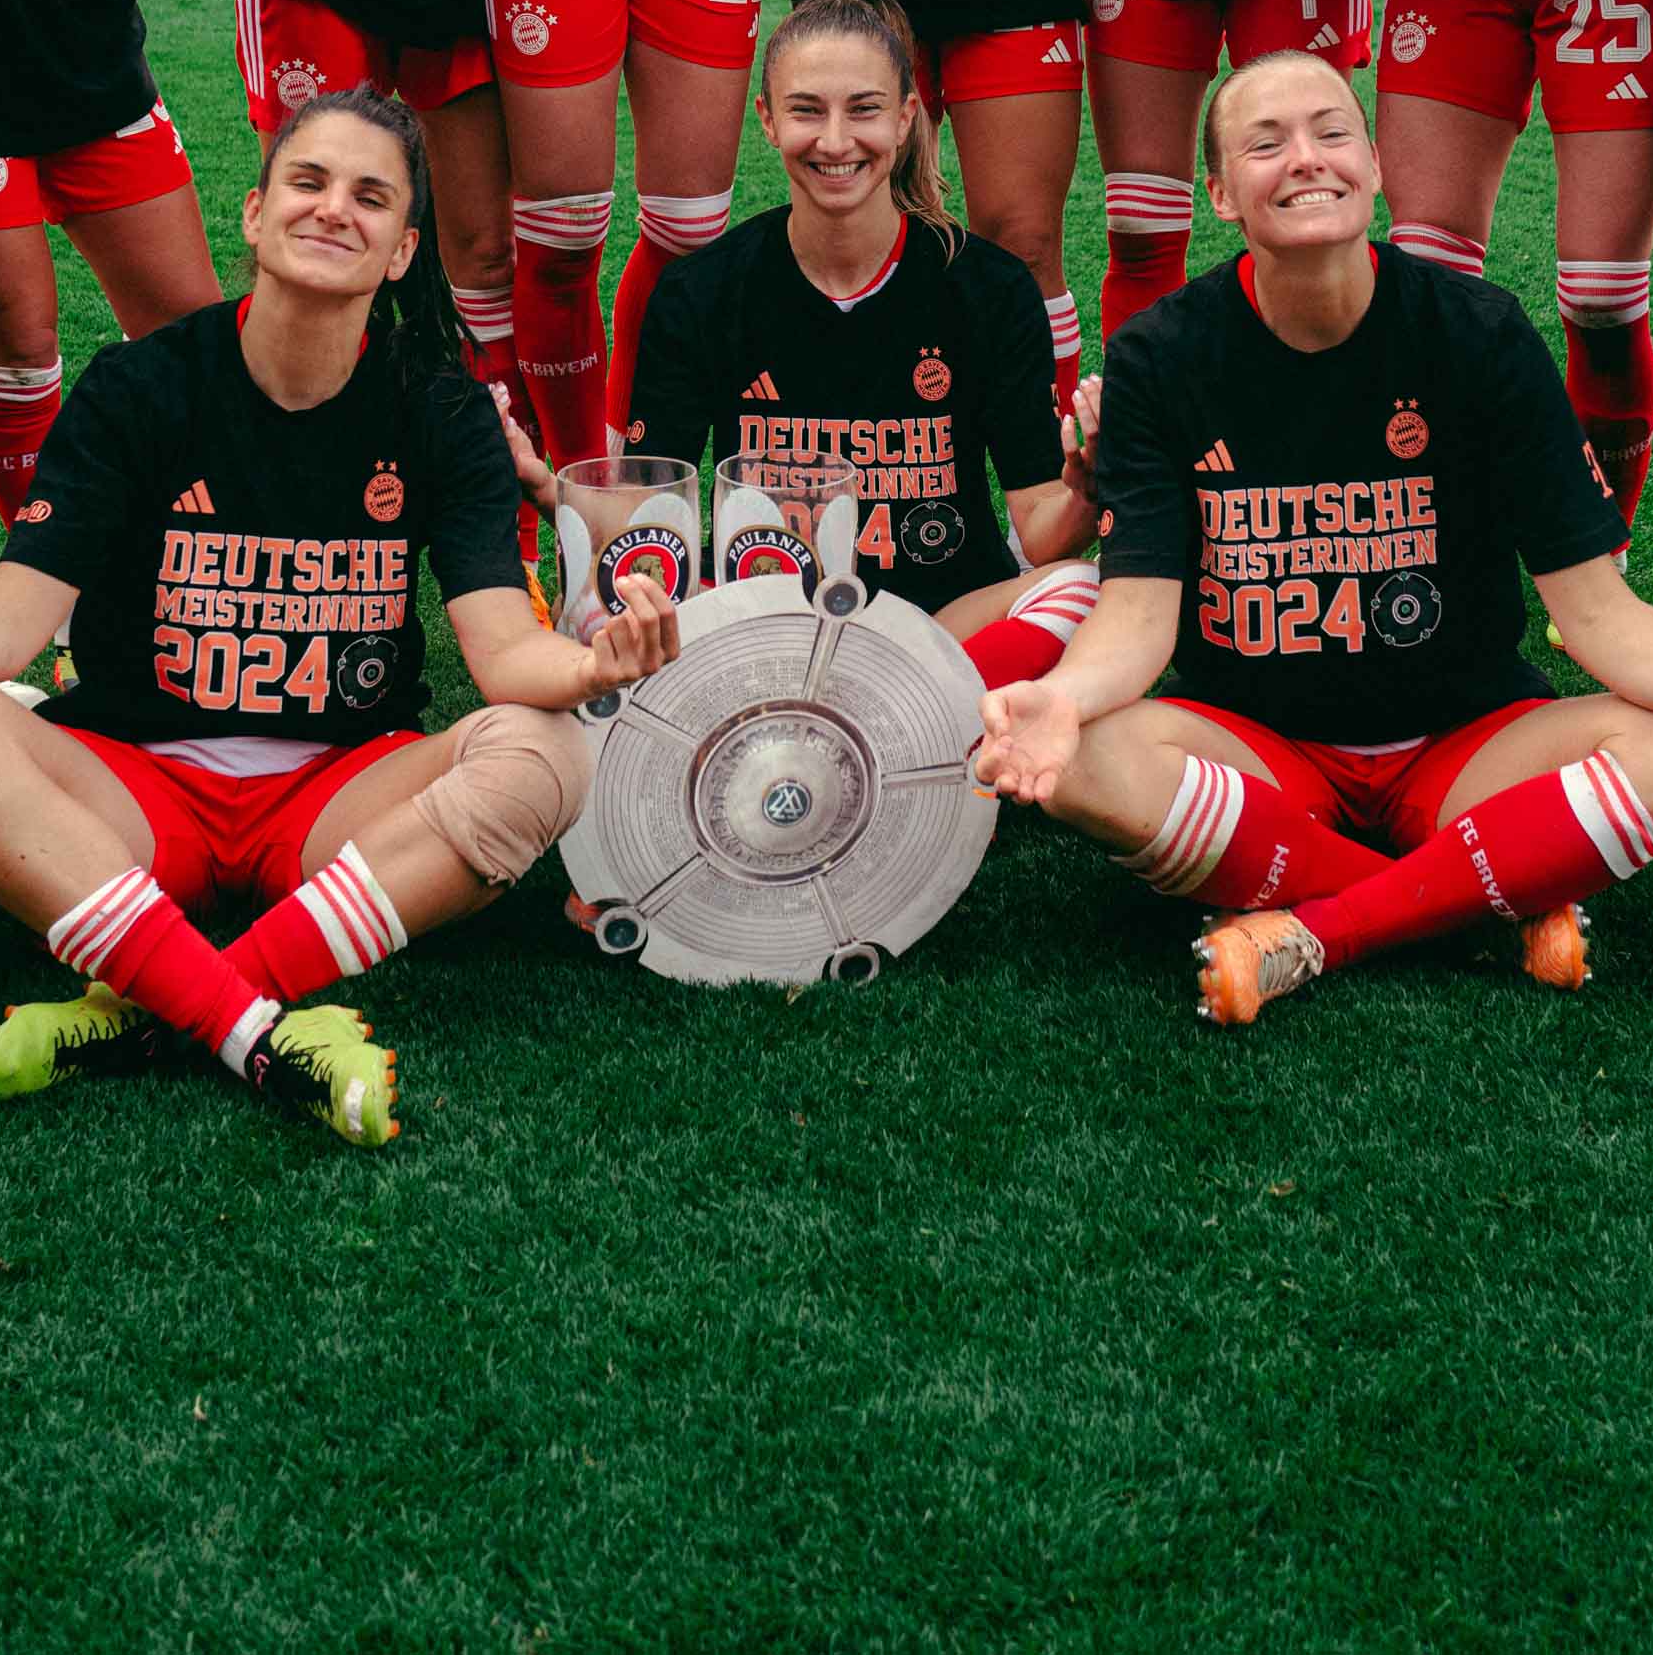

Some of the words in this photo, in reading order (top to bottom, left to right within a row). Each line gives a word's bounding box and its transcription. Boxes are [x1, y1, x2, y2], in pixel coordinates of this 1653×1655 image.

[532, 351, 599, 377] BAYERN
[738, 414, 955, 466] DEUTSCHE
[1196, 476, 1437, 541] DEUTSCHE
[157, 530, 408, 592] DEUTSCHE
[602, 527, 687, 568] PAULANER
[729, 530, 812, 568] PAULANER
[1200, 529, 1438, 581] MEISTERINNEN
[154, 584, 407, 633] MEISTERINNEN
[1198, 578, 1366, 656] 2024
[153, 625, 331, 714] 2024
[1457, 815, 1478, 847] FC
